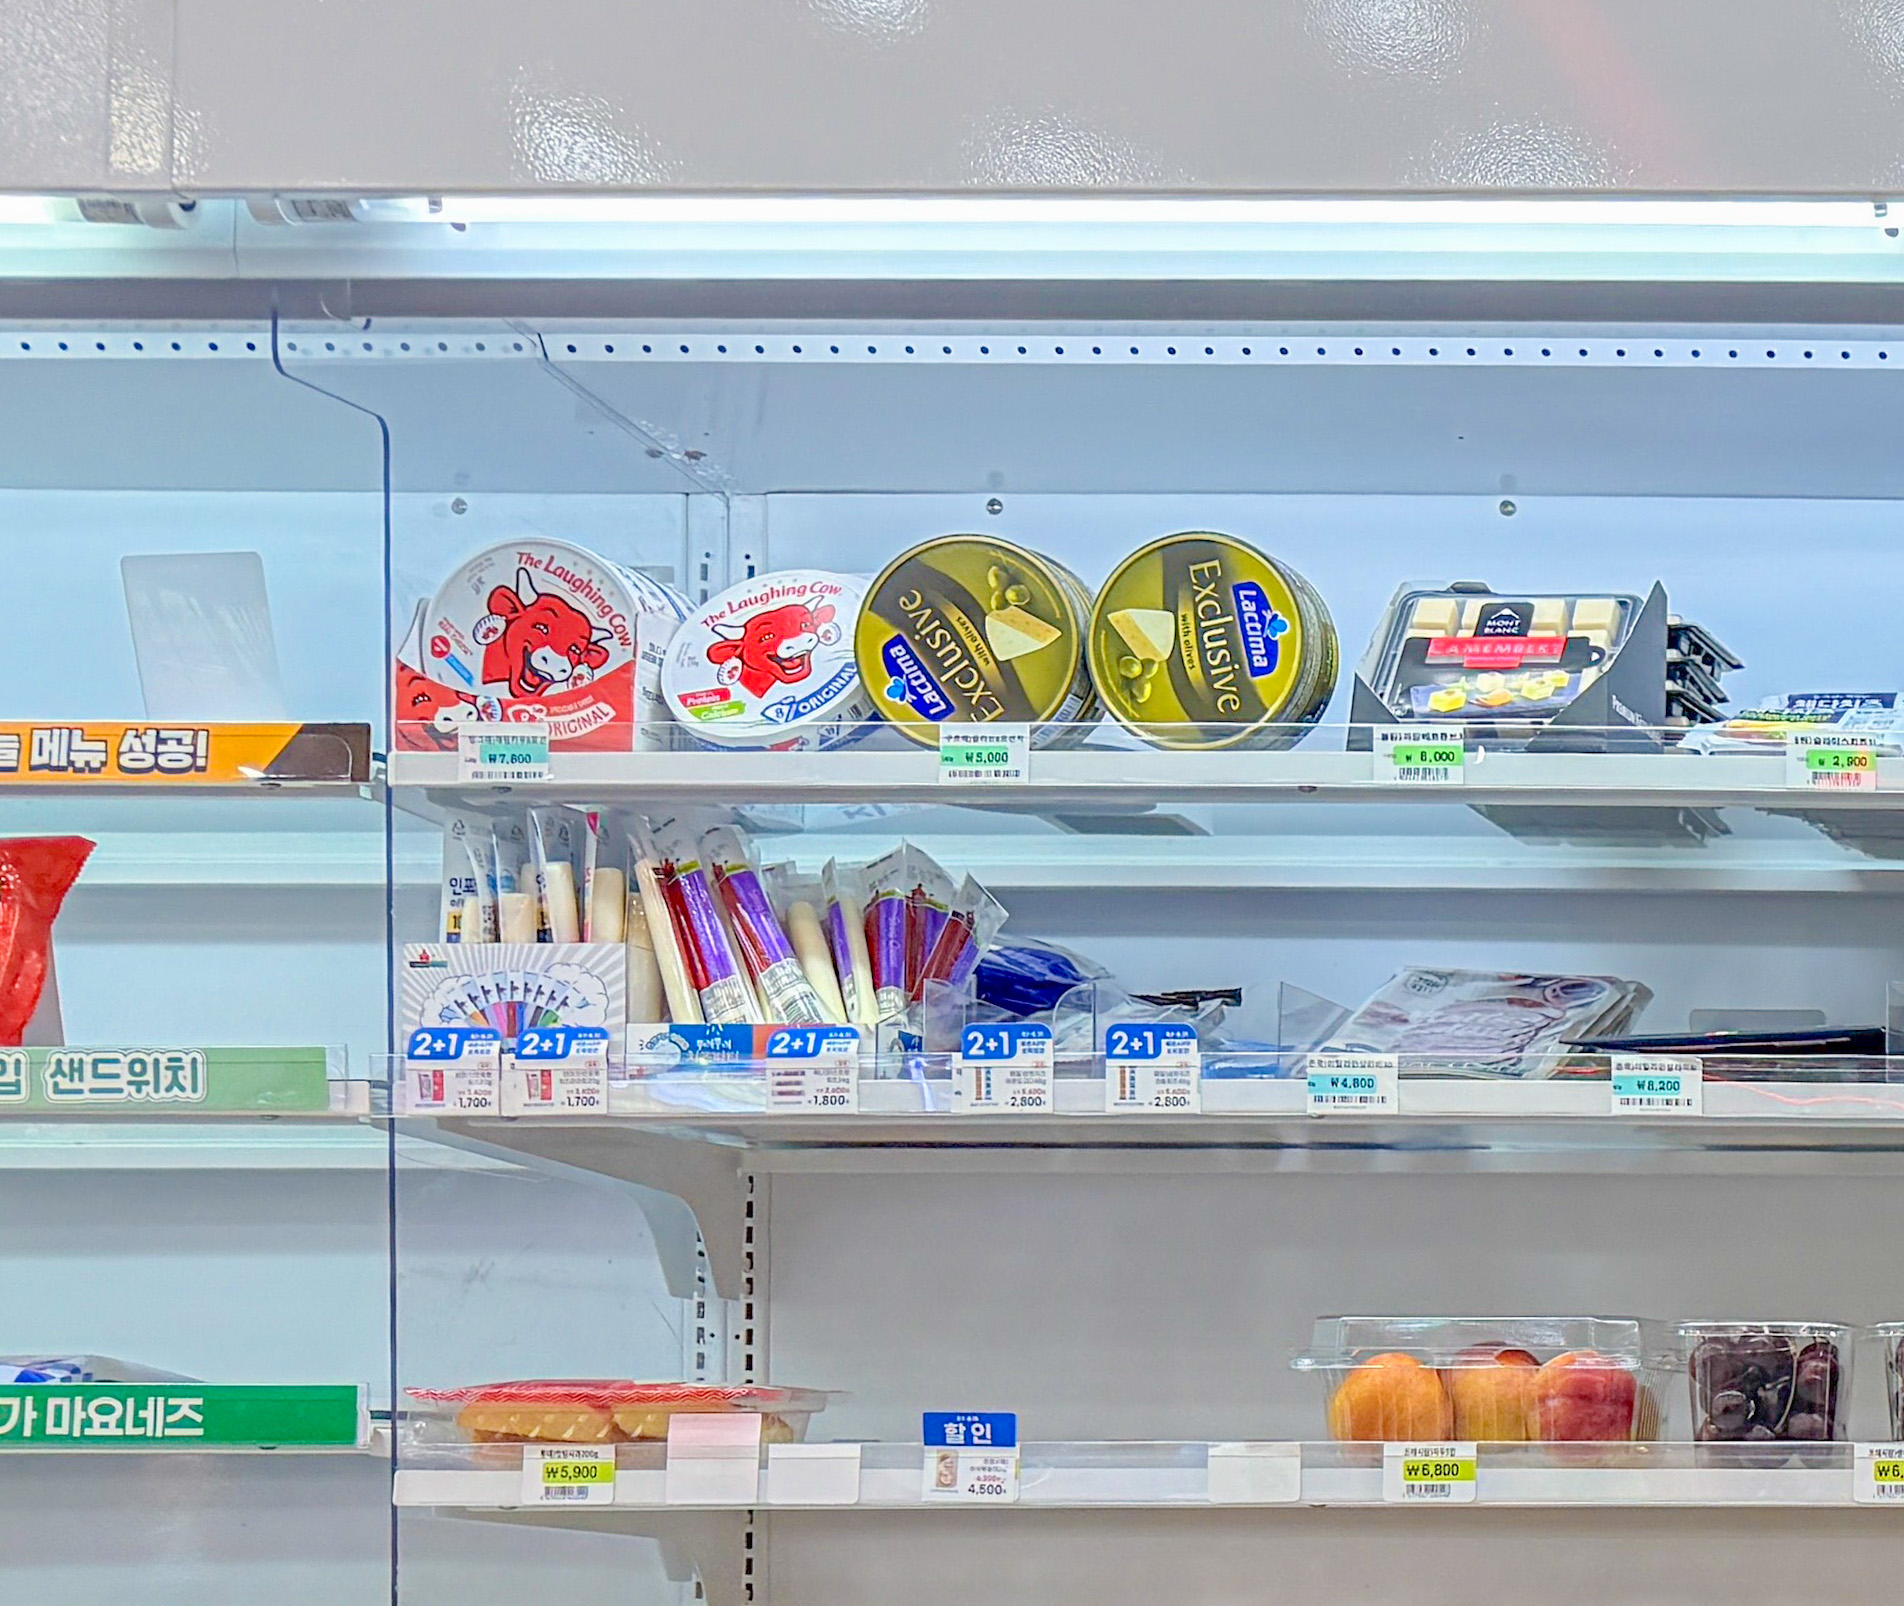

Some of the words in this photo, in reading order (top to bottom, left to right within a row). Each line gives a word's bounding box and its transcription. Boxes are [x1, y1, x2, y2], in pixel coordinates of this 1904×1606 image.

[516, 551, 543, 569] The
[543, 555, 617, 619] Laughing
[606, 611, 632, 649] Cow
[700, 606, 727, 628] The
[726, 583, 812, 612] Laughing
[808, 579, 842, 598] Cow
[1188, 558, 1242, 715] Exclusive
[30, 730, 107, 768] 메뉴
[120, 730, 208, 770] 성공!
[414, 1032, 463, 1057] 2+1
[519, 1032, 566, 1056] 2+1
[771, 1031, 816, 1055] 2+1
[967, 1031, 1011, 1056] 2+1
[1112, 1031, 1156, 1056] 2+1
[50, 1057, 200, 1097] 샌드위치
[46, 1398, 204, 1437] 마요네즈
[942, 1421, 995, 1446] 할인
[546, 1464, 599, 1480] ₩5,900
